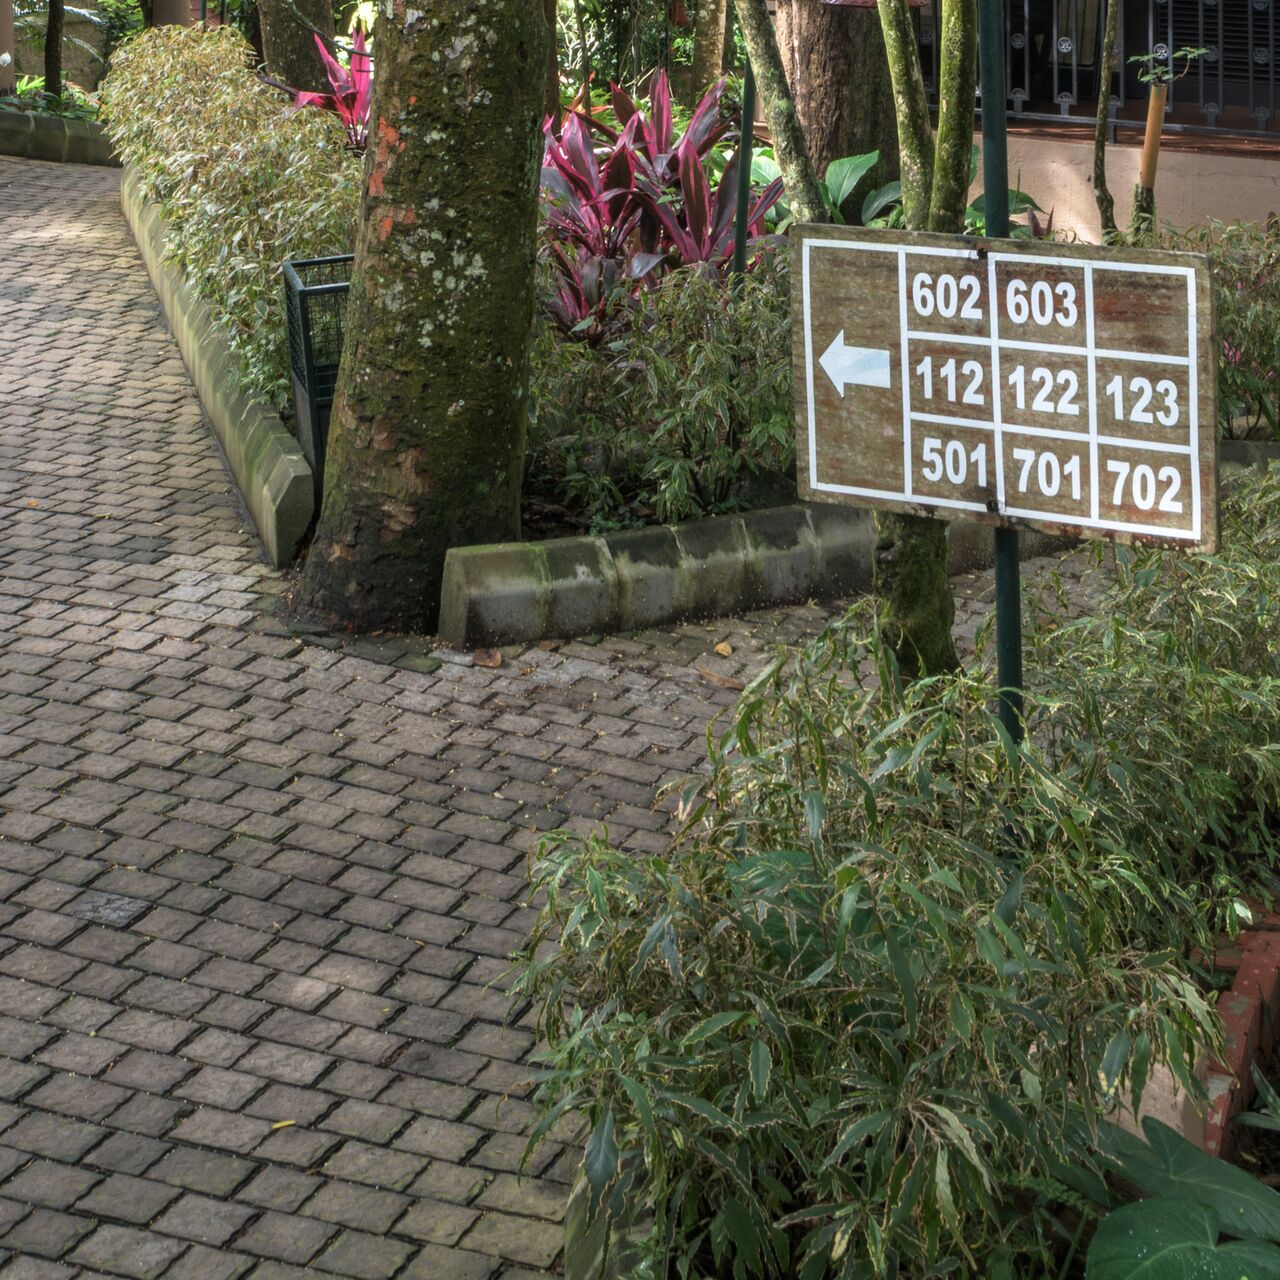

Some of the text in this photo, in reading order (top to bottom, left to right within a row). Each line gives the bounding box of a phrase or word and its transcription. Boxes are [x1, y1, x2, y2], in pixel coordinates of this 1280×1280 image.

[912, 272, 1078, 329] 602 603
[916, 355, 1180, 427] 112 122 123
[921, 436, 1183, 515] 501 701 702
